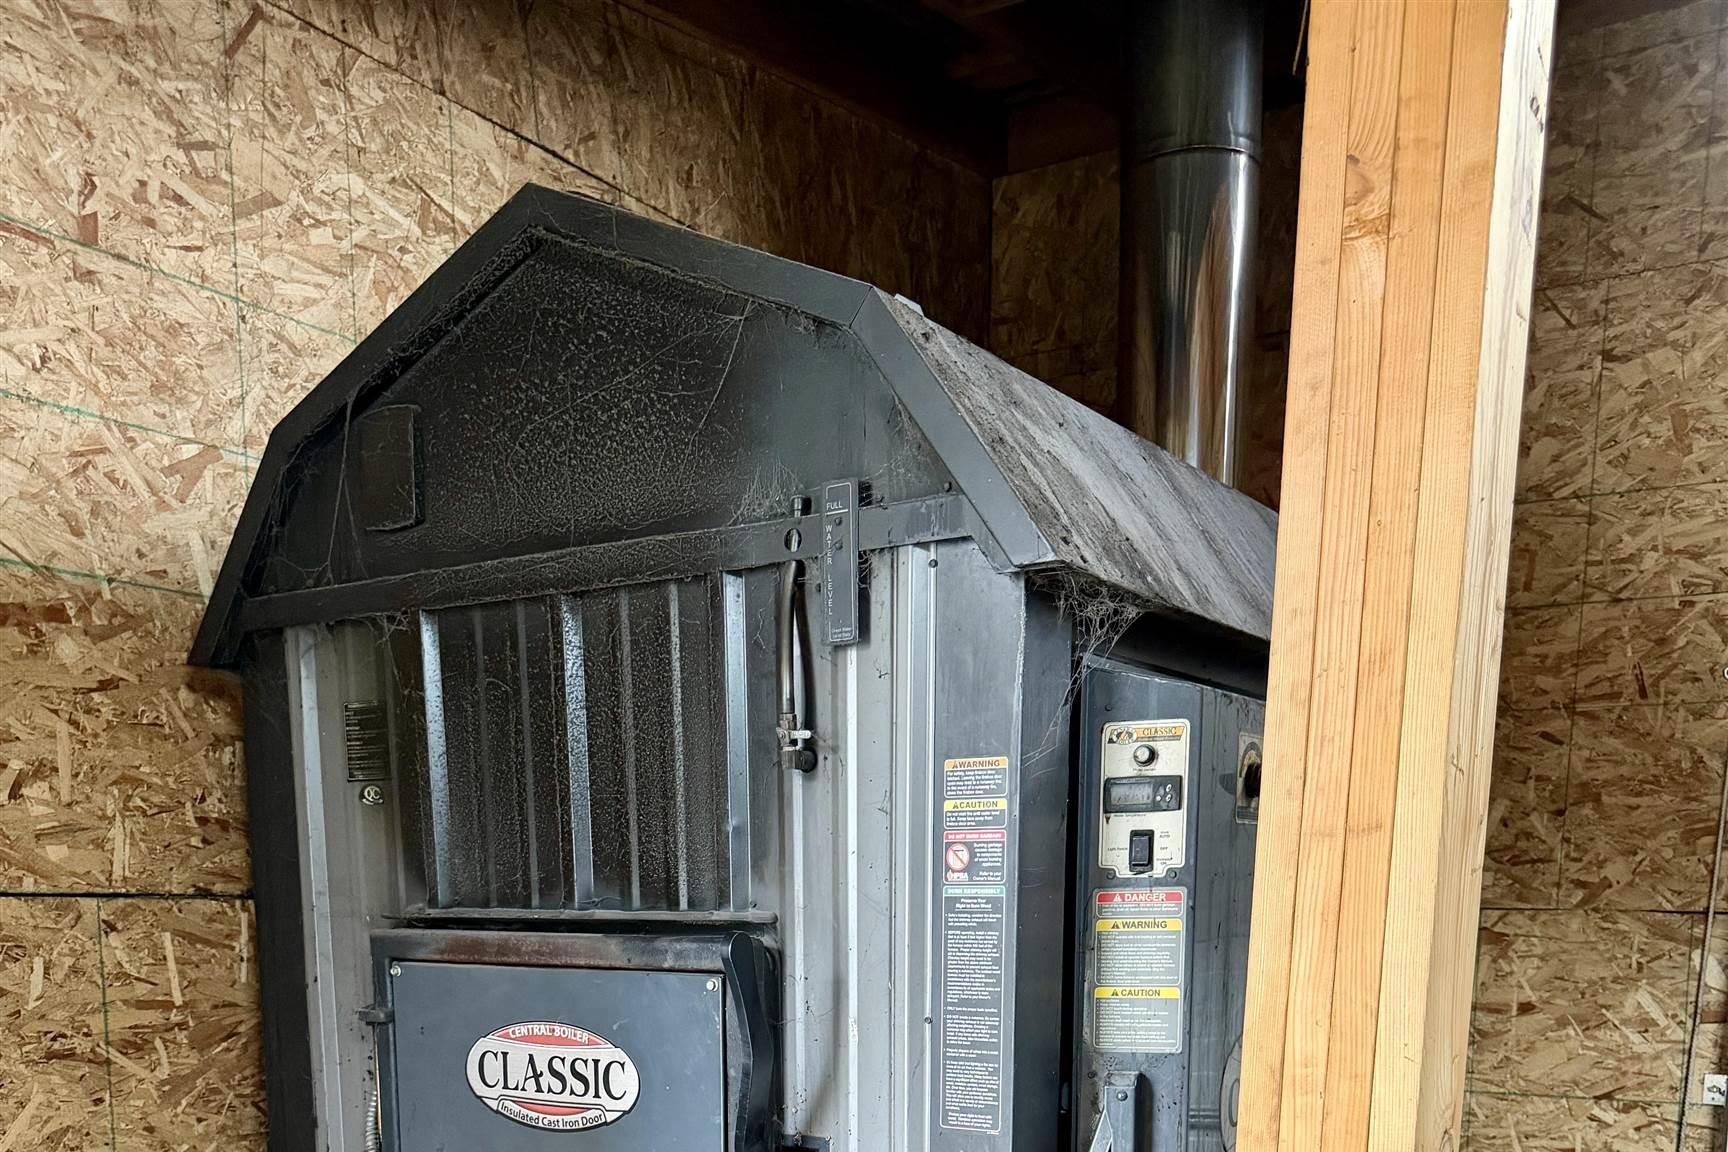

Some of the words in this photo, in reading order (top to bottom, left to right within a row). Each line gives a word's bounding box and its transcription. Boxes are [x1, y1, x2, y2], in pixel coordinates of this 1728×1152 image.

[826, 500, 843, 511] FULL
[825, 524, 833, 565] WATER
[1143, 727, 1177, 736] CLASSIC
[958, 760, 1000, 768] WARNING
[960, 801, 998, 809] CAUTION
[1124, 893, 1166, 902] DANGER
[1122, 920, 1167, 929] WARNING
[1121, 989, 1160, 997] CAUTION
[509, 1025, 552, 1039] CENTRAL
[553, 1027, 590, 1045] BOILER
[478, 1050, 627, 1101] CLASSIC
[500, 1101, 540, 1125] Insulated
[541, 1116, 560, 1128] Cast
[562, 1117, 579, 1128] Iron
[581, 1112, 603, 1127] Door
